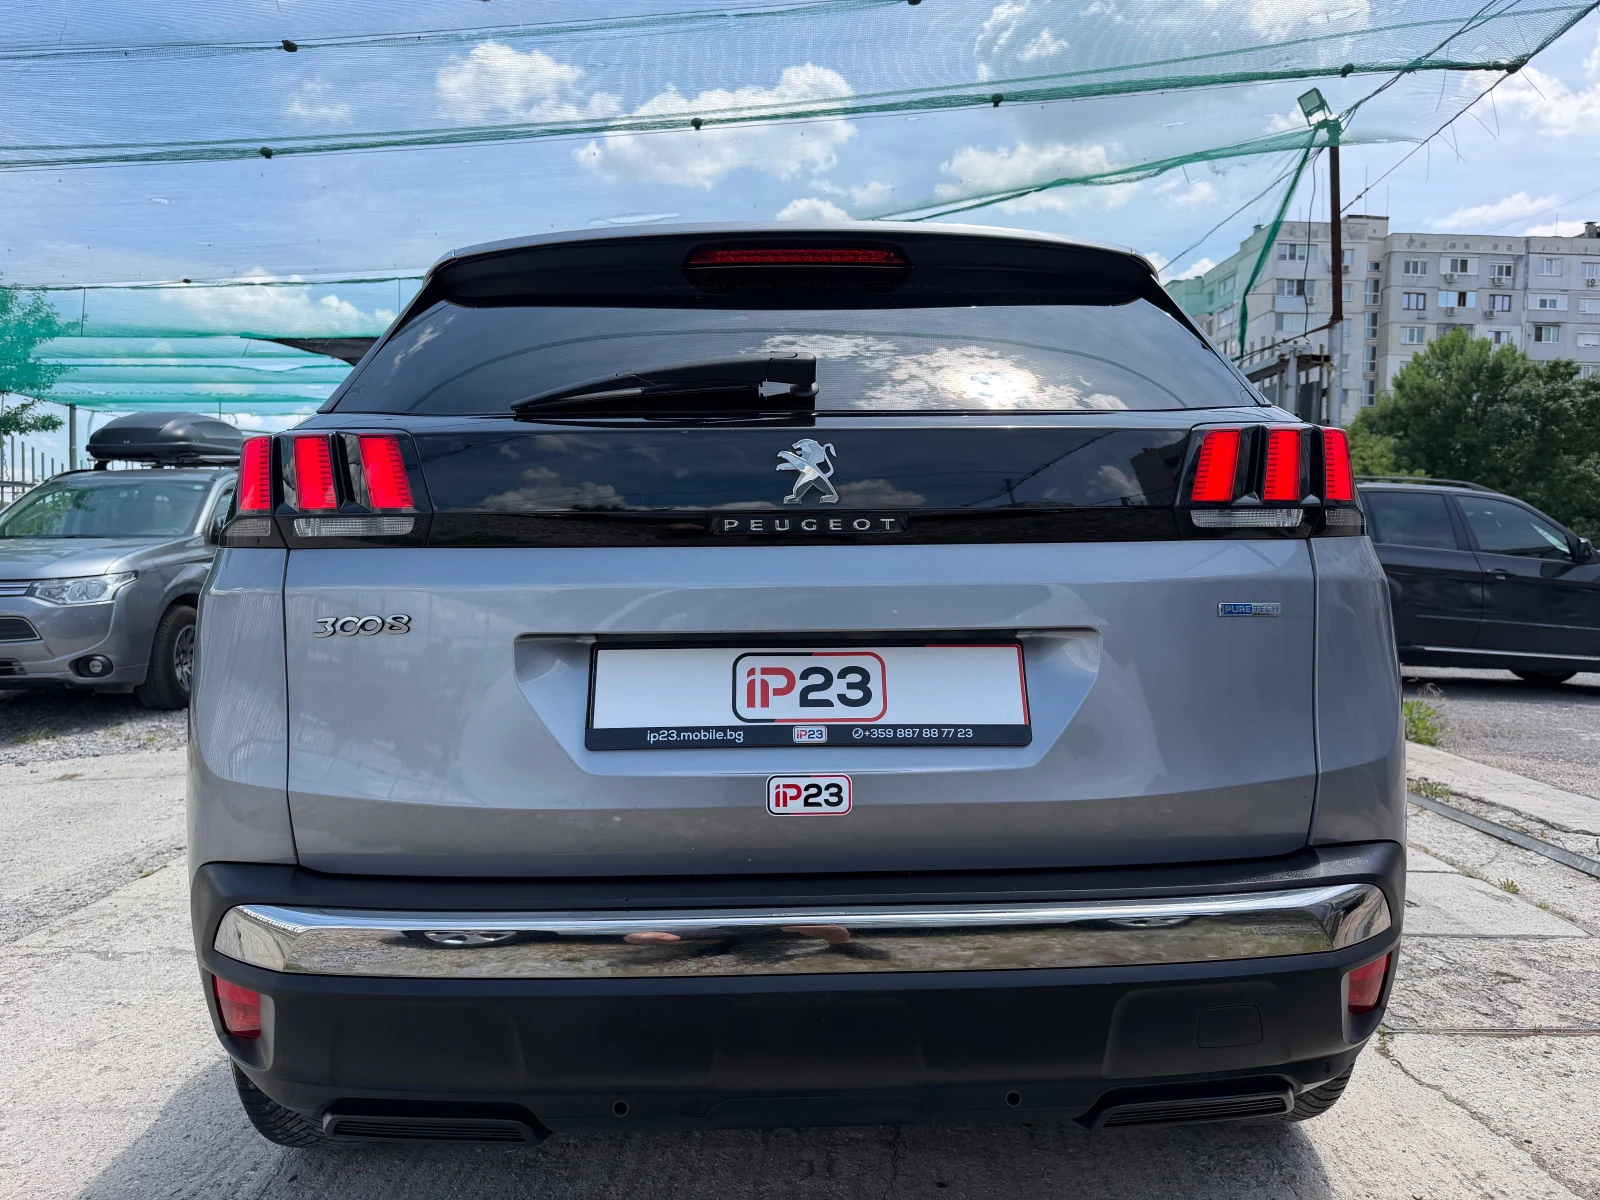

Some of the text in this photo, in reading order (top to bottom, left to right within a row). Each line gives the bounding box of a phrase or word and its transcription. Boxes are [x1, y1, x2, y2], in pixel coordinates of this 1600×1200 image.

[724, 518, 895, 531] PEUGEOT
[312, 614, 412, 638] 3008
[647, 729, 744, 744] ip23.mobile.bg
[864, 728, 973, 738] +359 887 88 77 23
